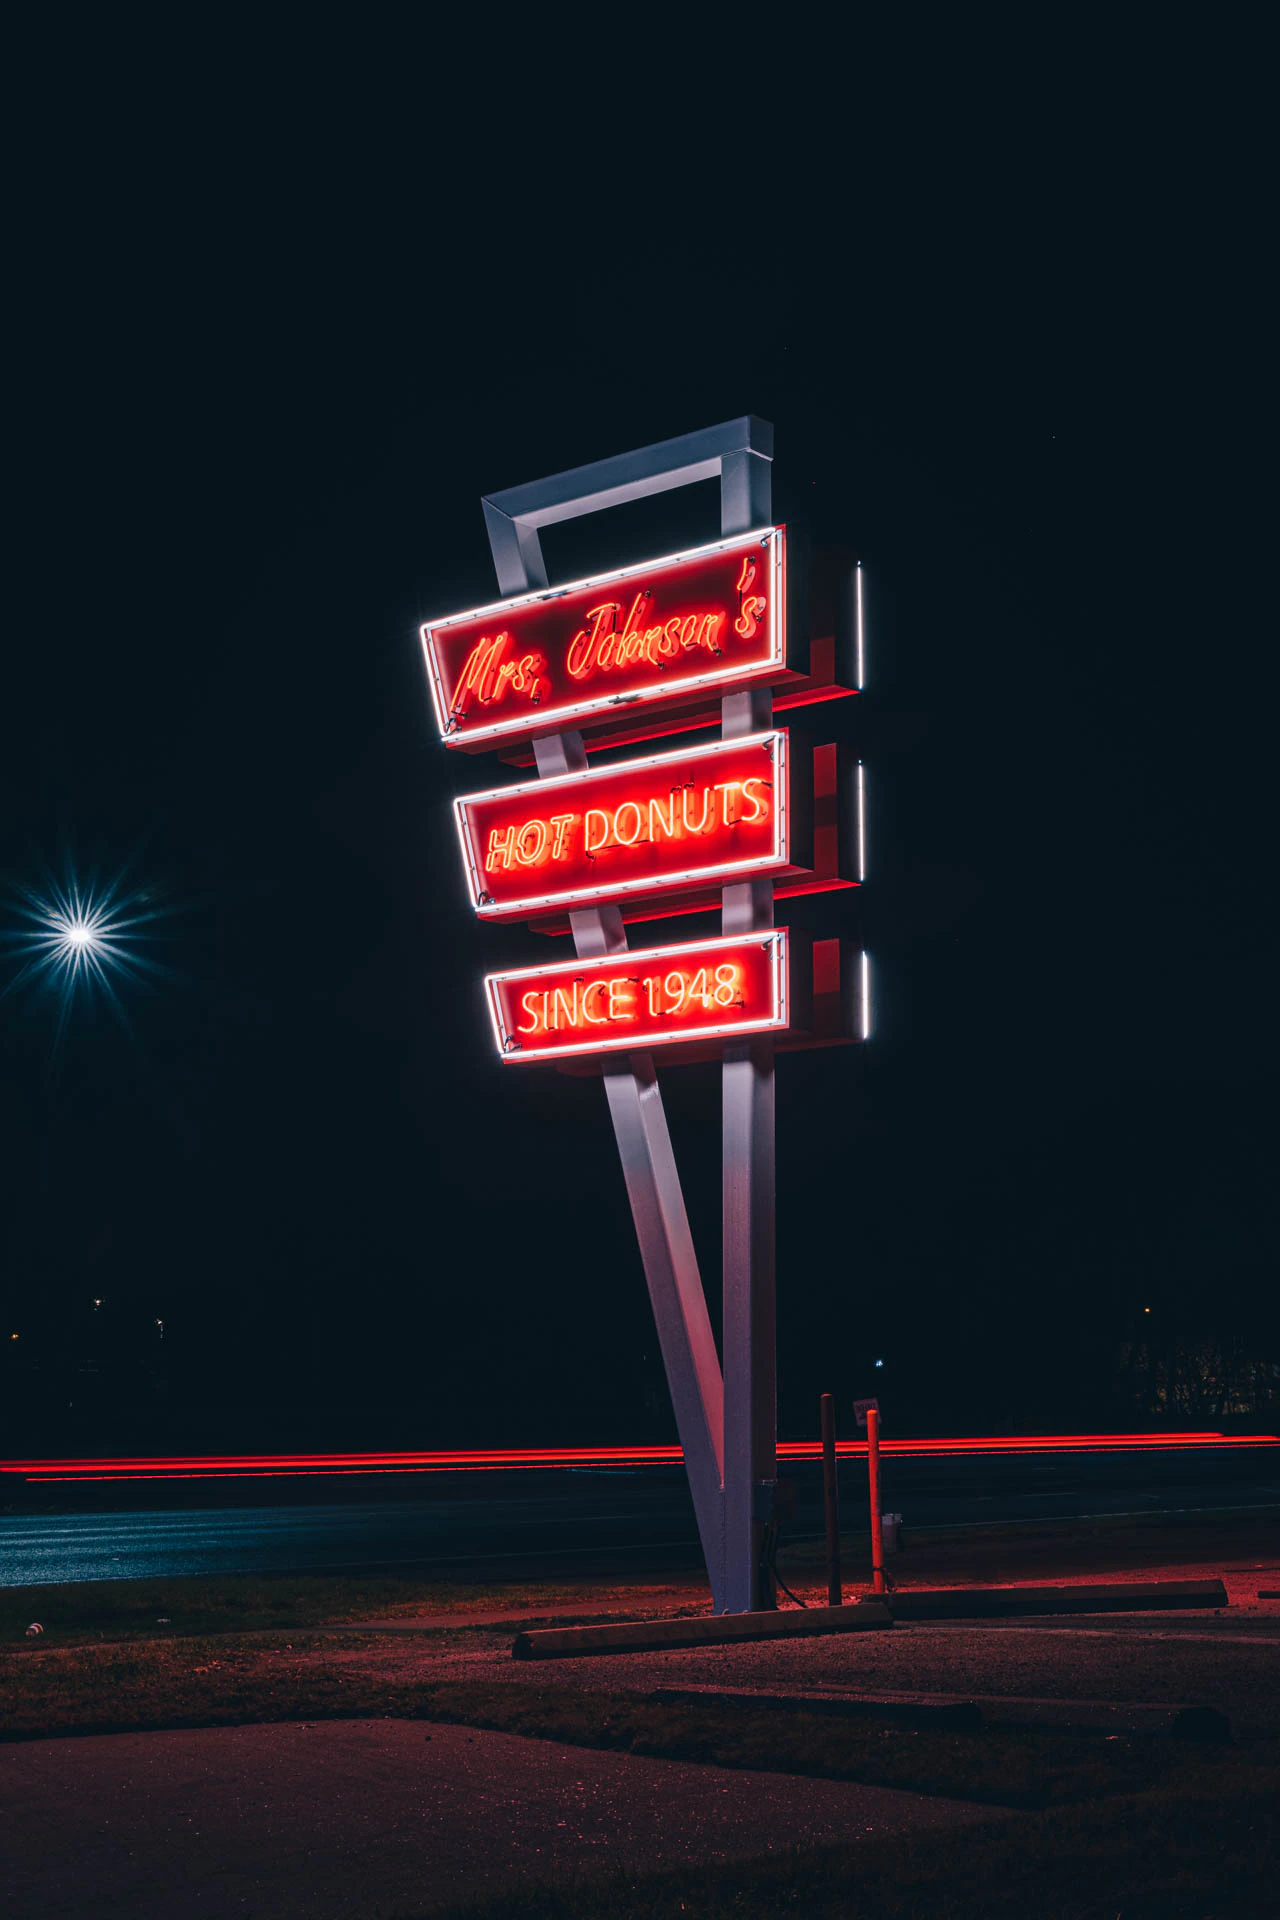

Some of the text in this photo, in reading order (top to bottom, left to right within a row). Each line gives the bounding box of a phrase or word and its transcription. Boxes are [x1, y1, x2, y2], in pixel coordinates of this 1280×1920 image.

[566, 556, 767, 676] Johnson's
[485, 778, 763, 872] HOT DONUTS
[518, 964, 738, 1034] SINCE 1948
